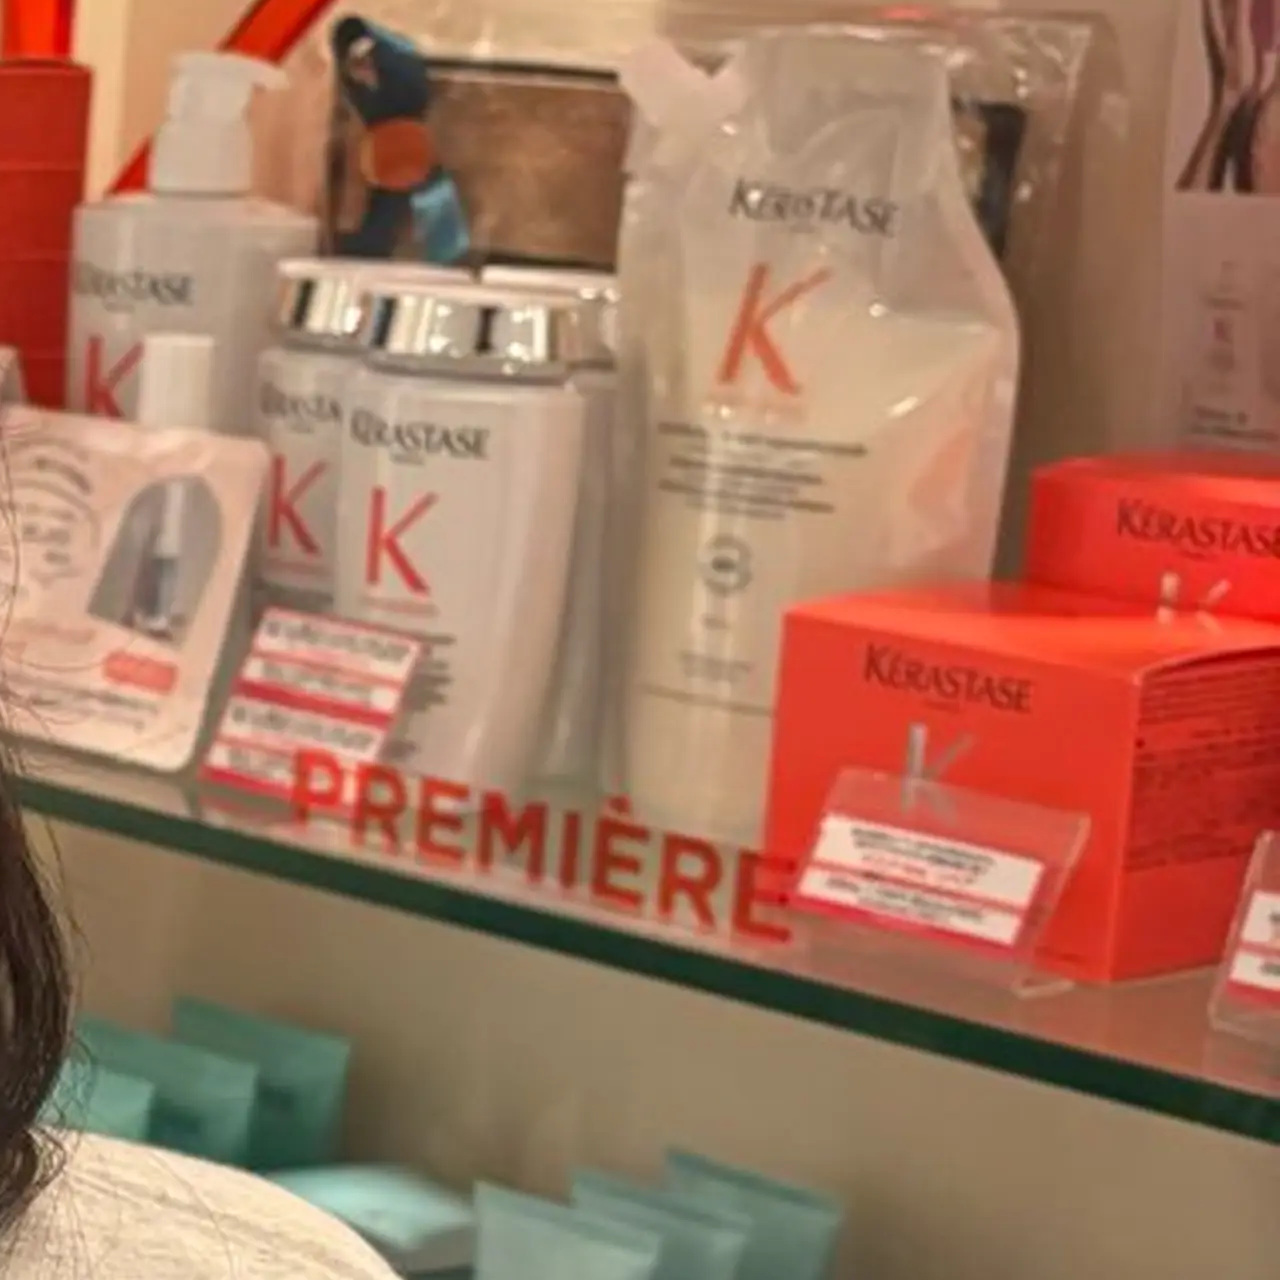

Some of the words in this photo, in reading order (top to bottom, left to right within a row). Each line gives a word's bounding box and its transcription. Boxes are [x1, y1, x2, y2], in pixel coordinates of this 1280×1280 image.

[716, 261, 836, 396] K
[267, 453, 329, 558] K
[365, 485, 440, 596] K
